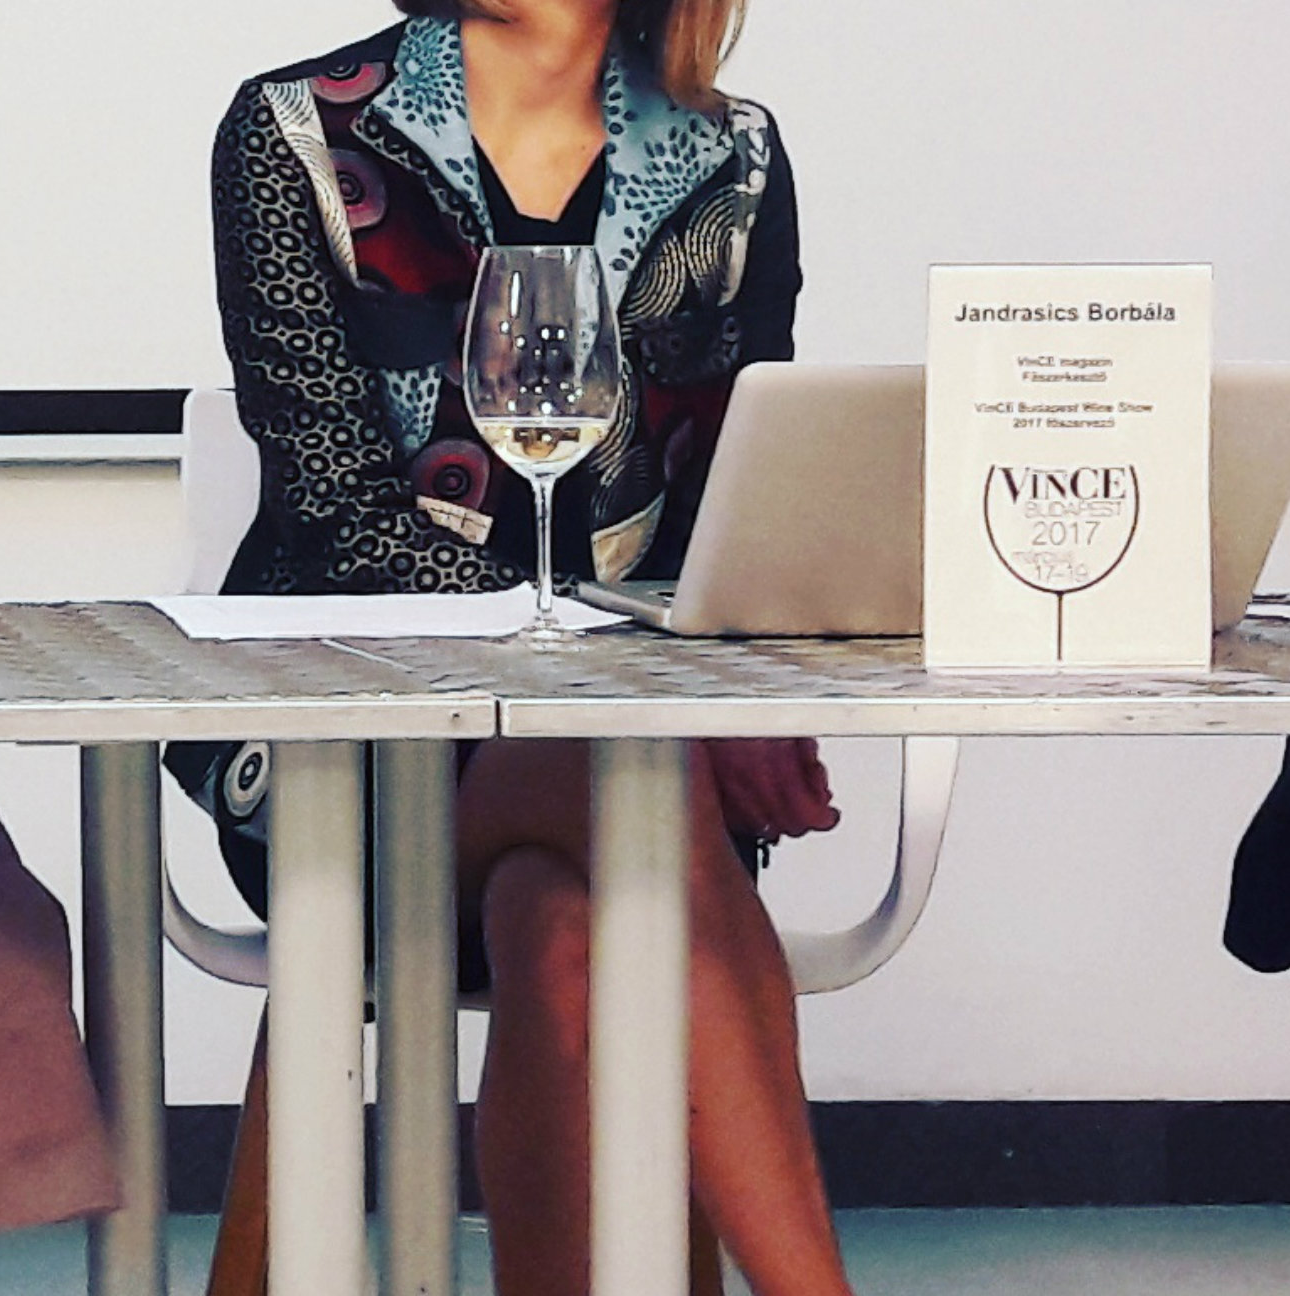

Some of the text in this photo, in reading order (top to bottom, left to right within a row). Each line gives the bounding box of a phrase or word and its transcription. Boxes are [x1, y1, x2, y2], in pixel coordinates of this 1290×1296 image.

[955, 302, 1176, 322] Jandrasics Borbála
[1032, 520, 1101, 546] 2017
